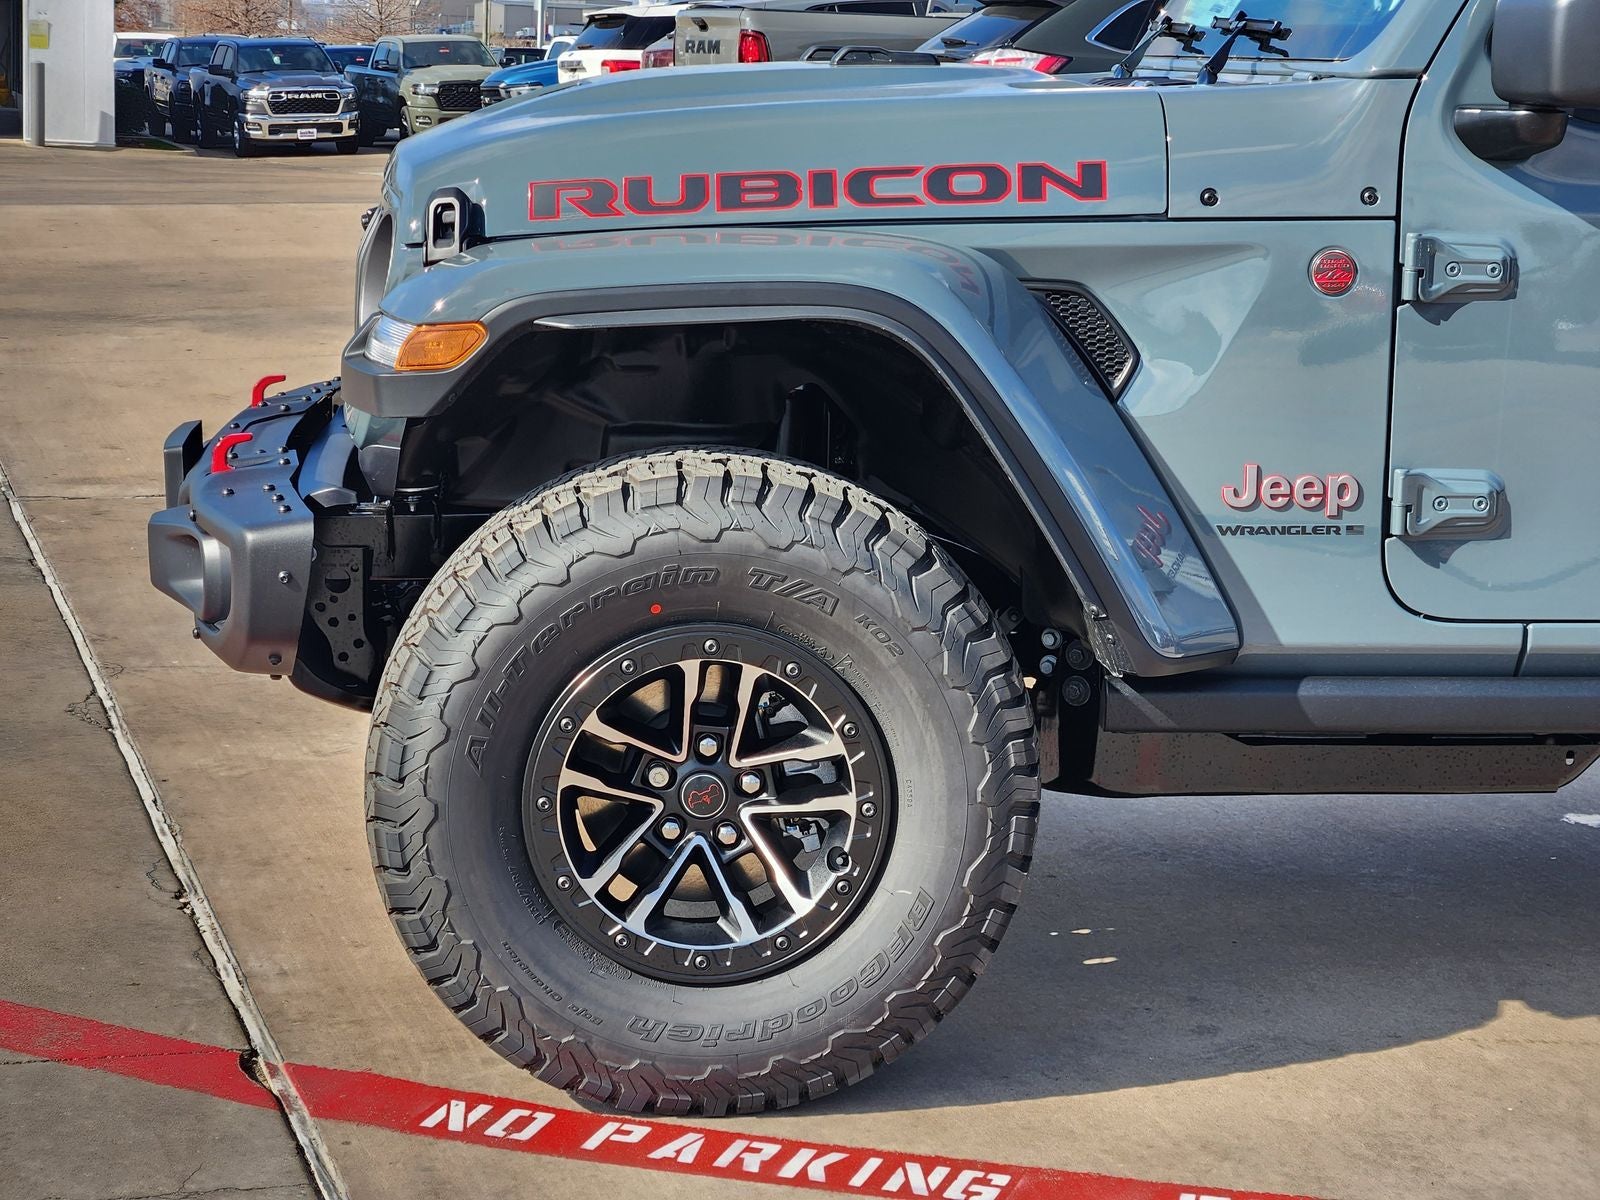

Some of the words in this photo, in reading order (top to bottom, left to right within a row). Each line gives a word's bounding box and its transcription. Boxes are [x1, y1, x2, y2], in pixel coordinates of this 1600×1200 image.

[685, 40, 721, 54] RAM
[527, 160, 1109, 221] RUBICON
[1222, 463, 1361, 518] Jeep
[1216, 524, 1342, 537] WRANGLER
[747, 566, 840, 617] T/A
[854, 613, 905, 658] KO2
[625, 886, 936, 1048] BFGoodrich
[419, 1099, 556, 1141] NO
[580, 1121, 1011, 1200] PARKING
